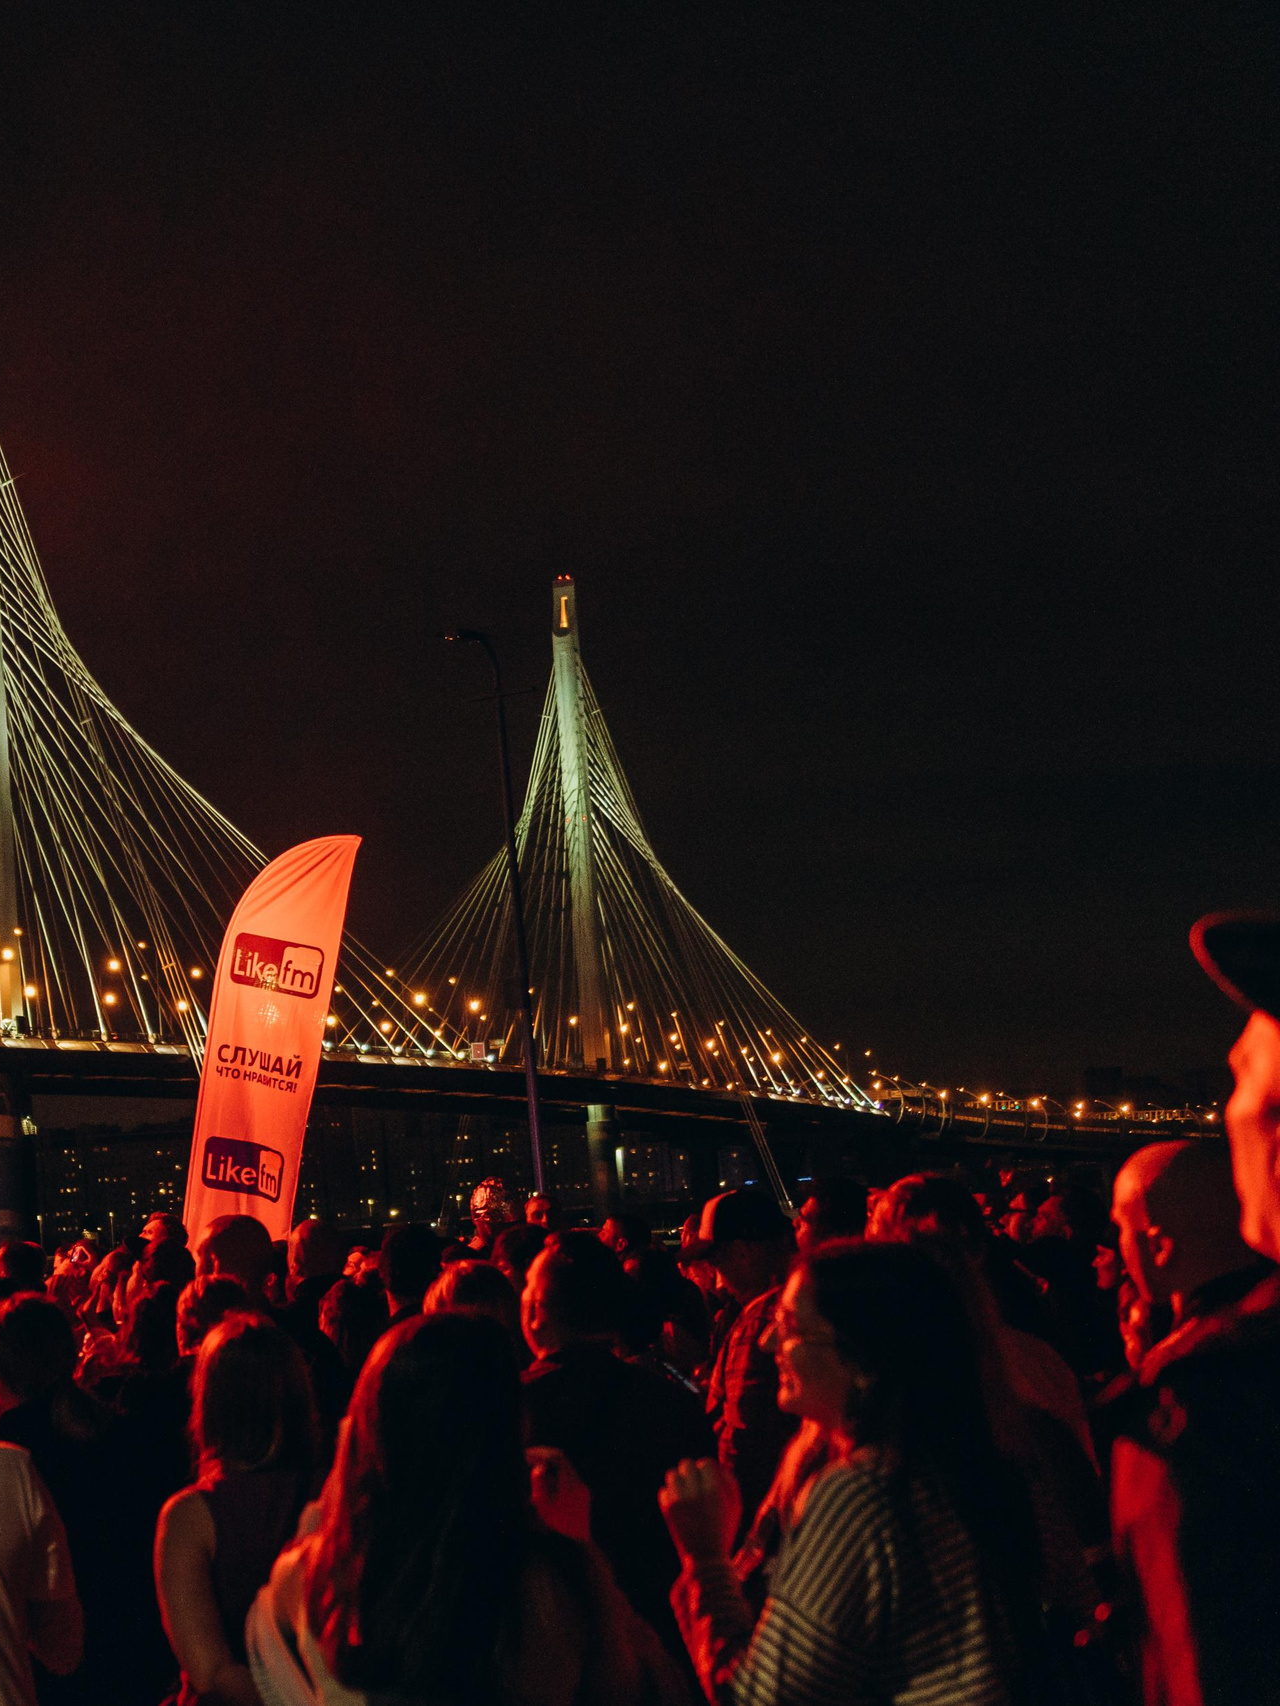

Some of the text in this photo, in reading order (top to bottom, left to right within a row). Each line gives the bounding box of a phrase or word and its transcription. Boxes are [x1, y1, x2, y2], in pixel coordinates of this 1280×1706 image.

[233, 948, 315, 990] Like fm
[215, 1065, 298, 1094] ЧТО НРАВИТСЯ!
[217, 1043, 303, 1079] СЛУШАЙ
[205, 1152, 277, 1195] Like fm
